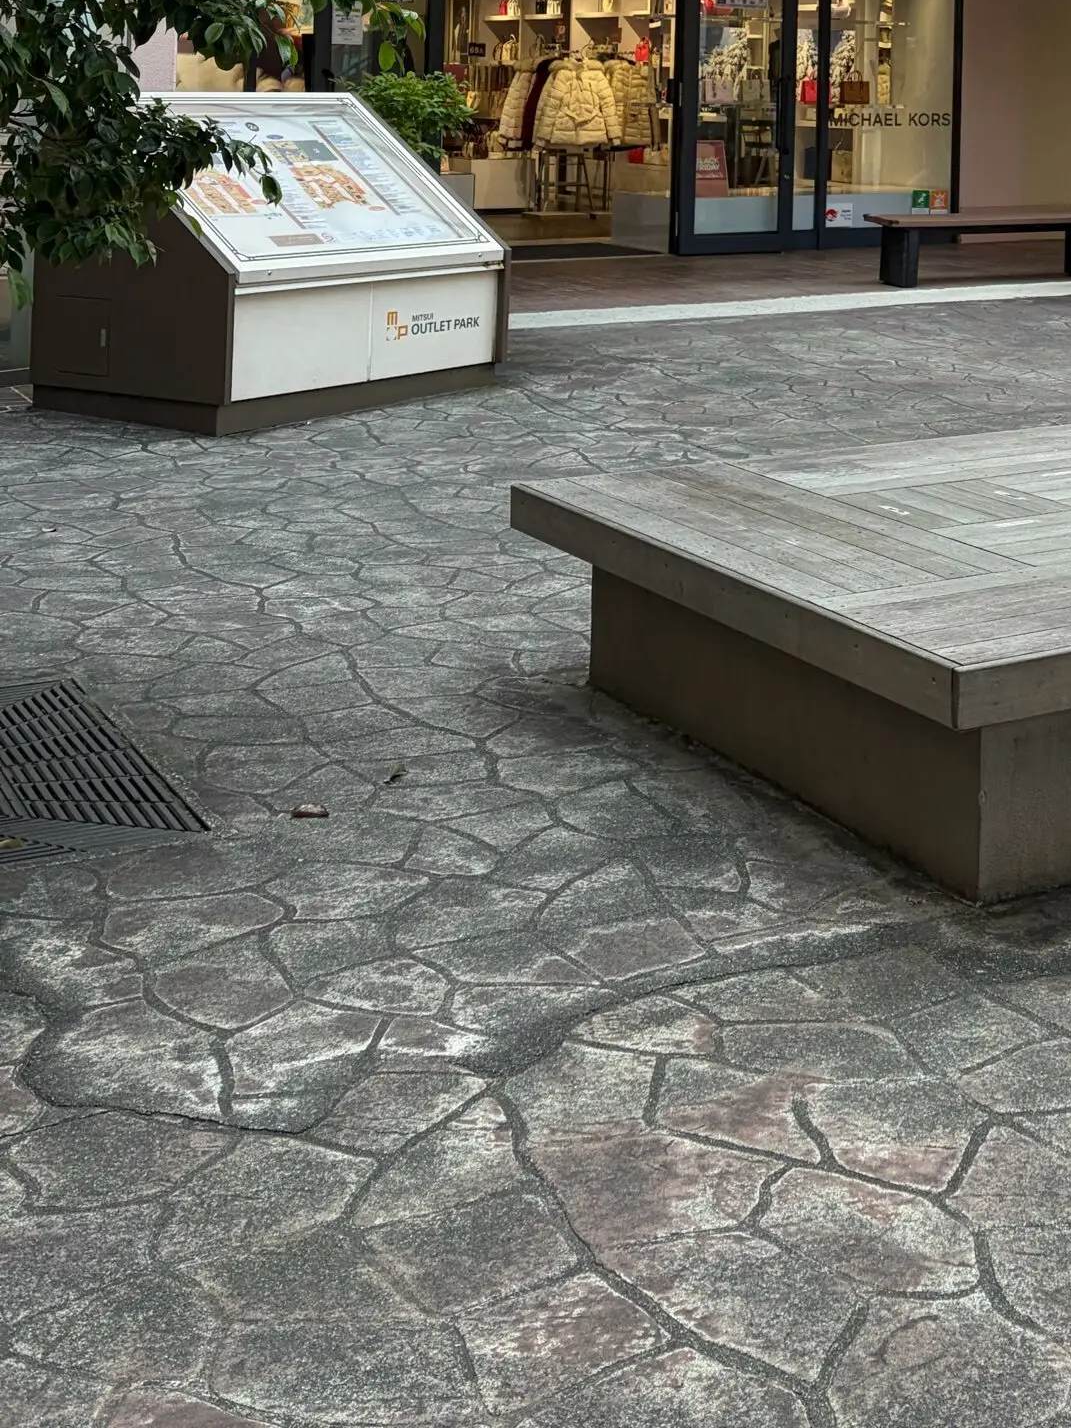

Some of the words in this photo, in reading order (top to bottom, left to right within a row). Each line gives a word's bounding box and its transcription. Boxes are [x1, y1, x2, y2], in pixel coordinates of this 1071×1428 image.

[829, 113, 902, 127] MICHAEL
[908, 113, 951, 127] KORS
[411, 313, 434, 323] MITSUI
[411, 319, 452, 335] OUTLET
[453, 316, 480, 330] PARK
